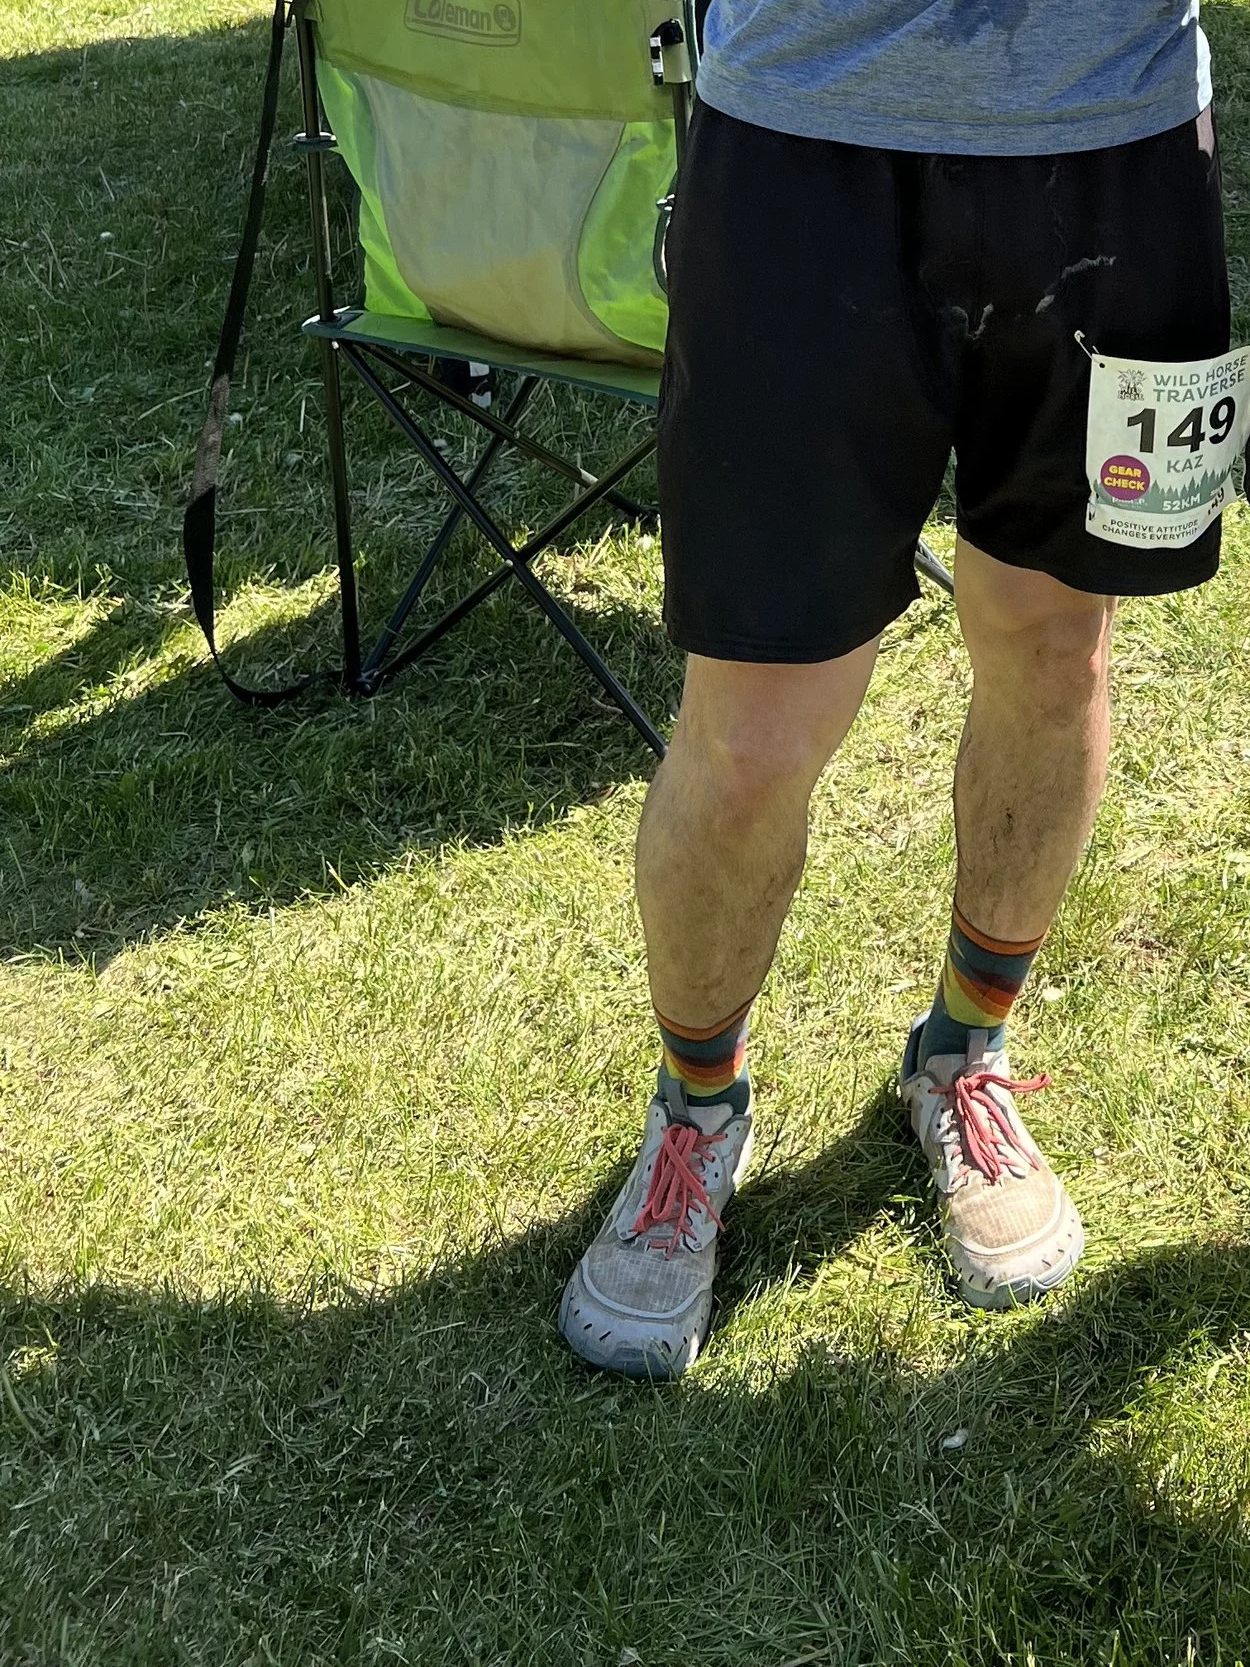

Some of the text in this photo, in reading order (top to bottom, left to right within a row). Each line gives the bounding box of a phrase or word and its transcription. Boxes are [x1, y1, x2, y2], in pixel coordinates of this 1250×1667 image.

[1153, 354, 1248, 387] WILD HORSE
[1152, 368, 1246, 403] TRAVERSE
[1127, 395, 1236, 453] 149
[1108, 465, 1142, 478] GEAR
[1166, 454, 1204, 473] KAZ
[1103, 476, 1145, 491] CHECK
[1162, 492, 1201, 511] 52KM
[1102, 524, 1147, 540] CHANGES
[1110, 519, 1199, 533] POSITIVE ATTITUDE
